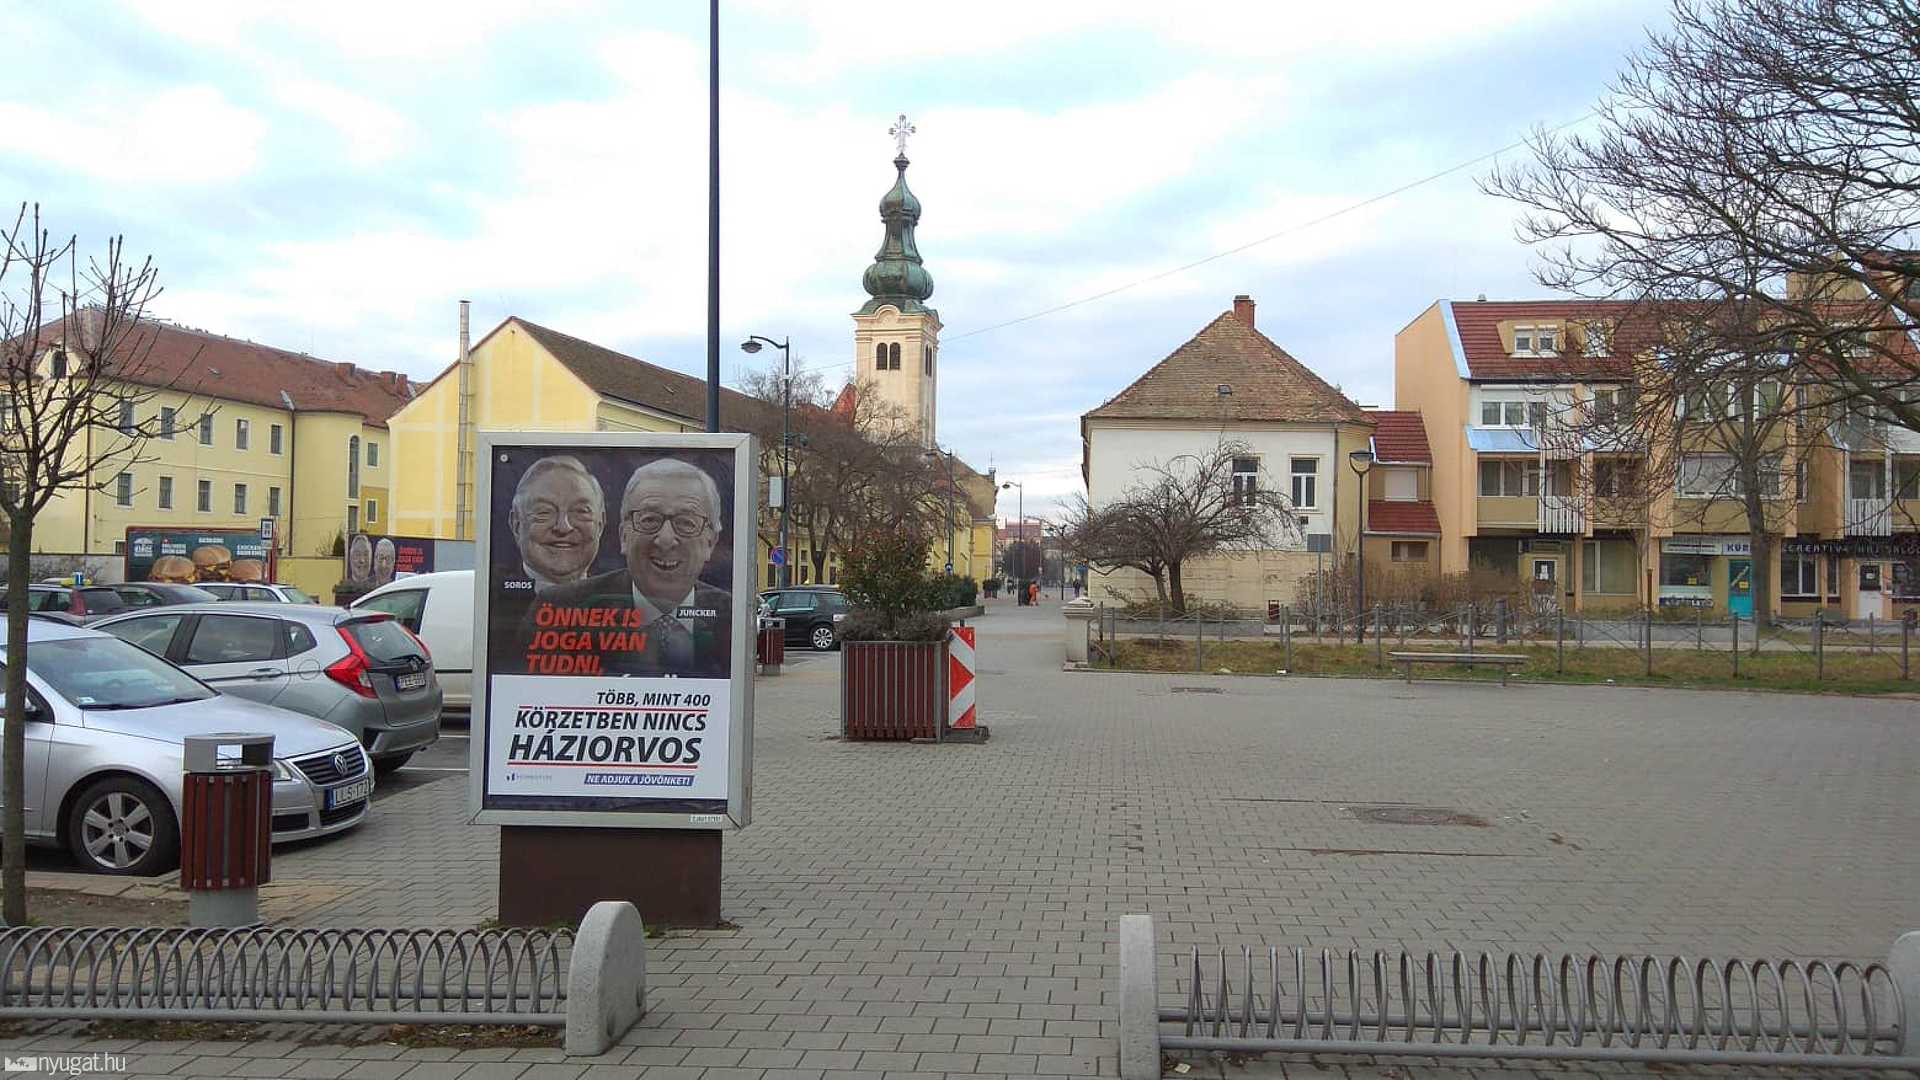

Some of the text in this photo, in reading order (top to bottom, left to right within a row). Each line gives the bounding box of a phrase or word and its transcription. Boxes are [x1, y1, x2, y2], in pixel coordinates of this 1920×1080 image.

[504, 581, 532, 590] SOROS
[535, 603, 642, 628] ÖNNEK IS
[678, 608, 717, 617] JUNCKER
[529, 631, 647, 652] JOGA VAN
[597, 689, 711, 707] TÖBB, MINT 400
[515, 706, 707, 732] KÖRZETBEN NINCS
[508, 729, 702, 764] HÁZIORVOS
[587, 775, 600, 784] NE
[601, 775, 631, 785] ADJUK
[632, 776, 639, 785] A
